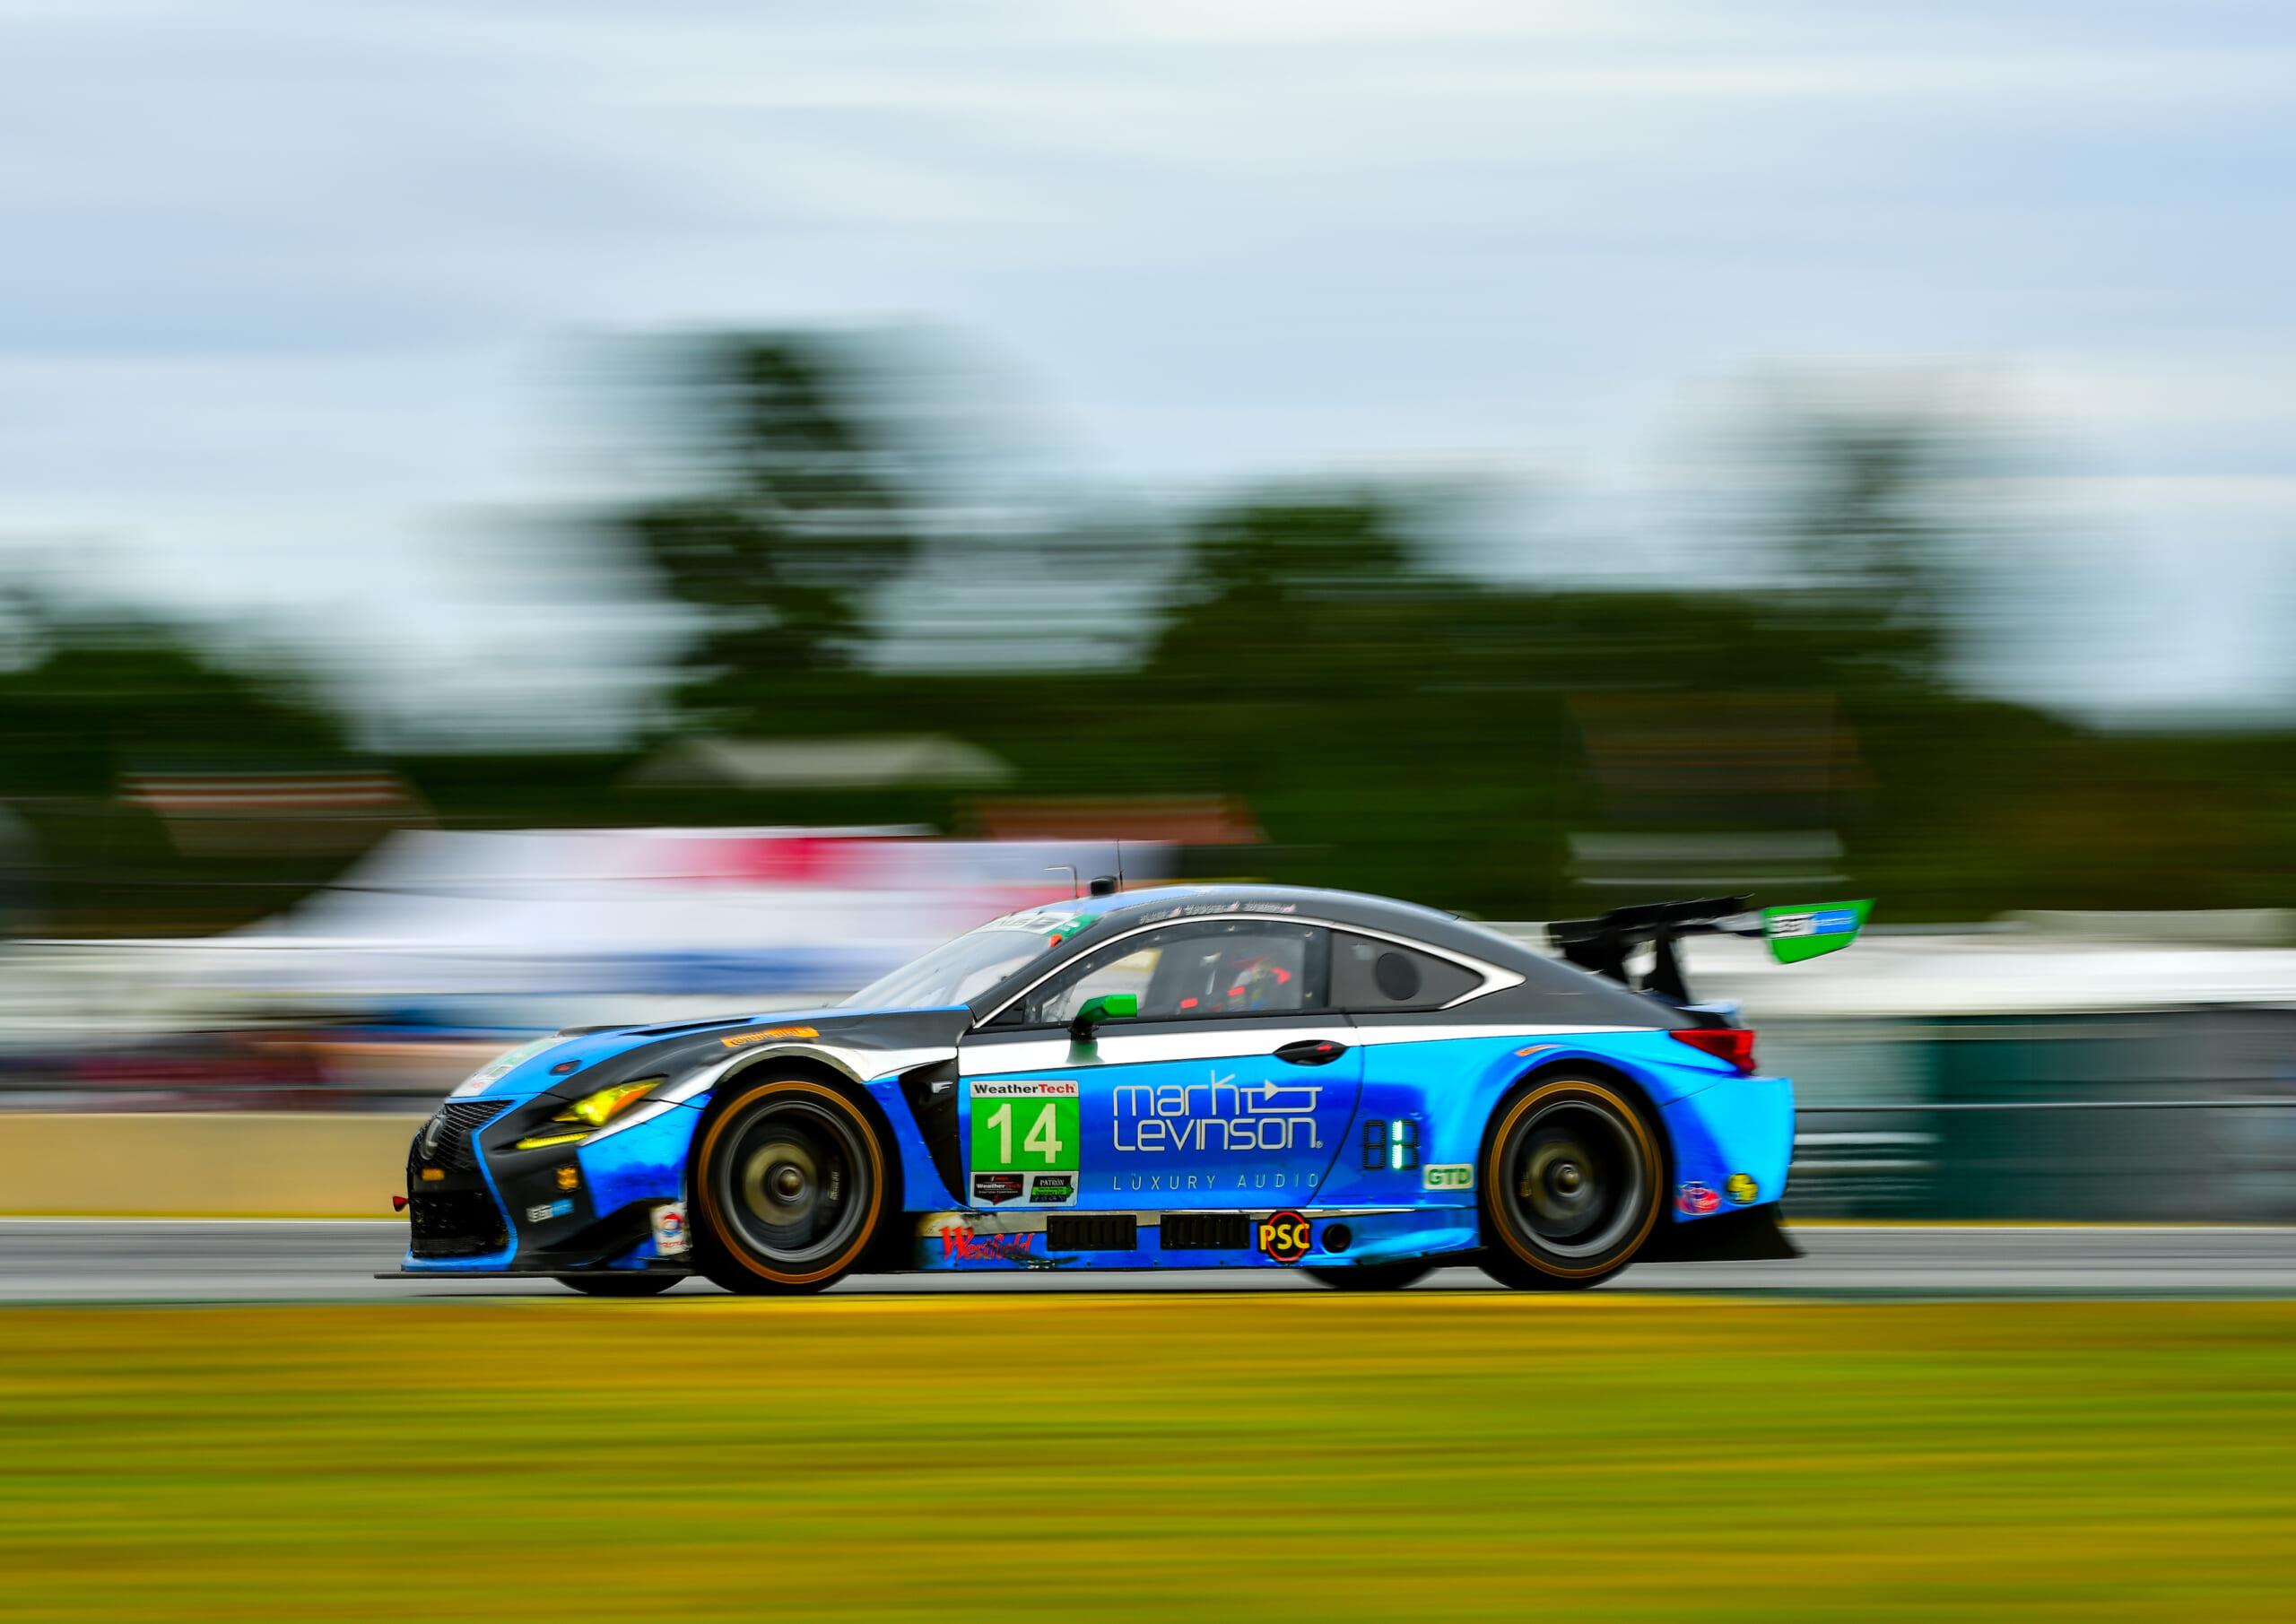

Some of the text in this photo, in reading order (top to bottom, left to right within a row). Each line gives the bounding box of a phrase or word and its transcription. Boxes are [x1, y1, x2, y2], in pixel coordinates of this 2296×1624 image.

[974, 1083, 1075, 1094] WeatherTech
[1113, 1070, 1240, 1116] mark
[987, 1103, 1063, 1164] 14
[1113, 1173, 1318, 1191] LUXURY AUDIO
[1427, 1168, 1472, 1185] GTD
[1259, 1223, 1310, 1251] PSC
